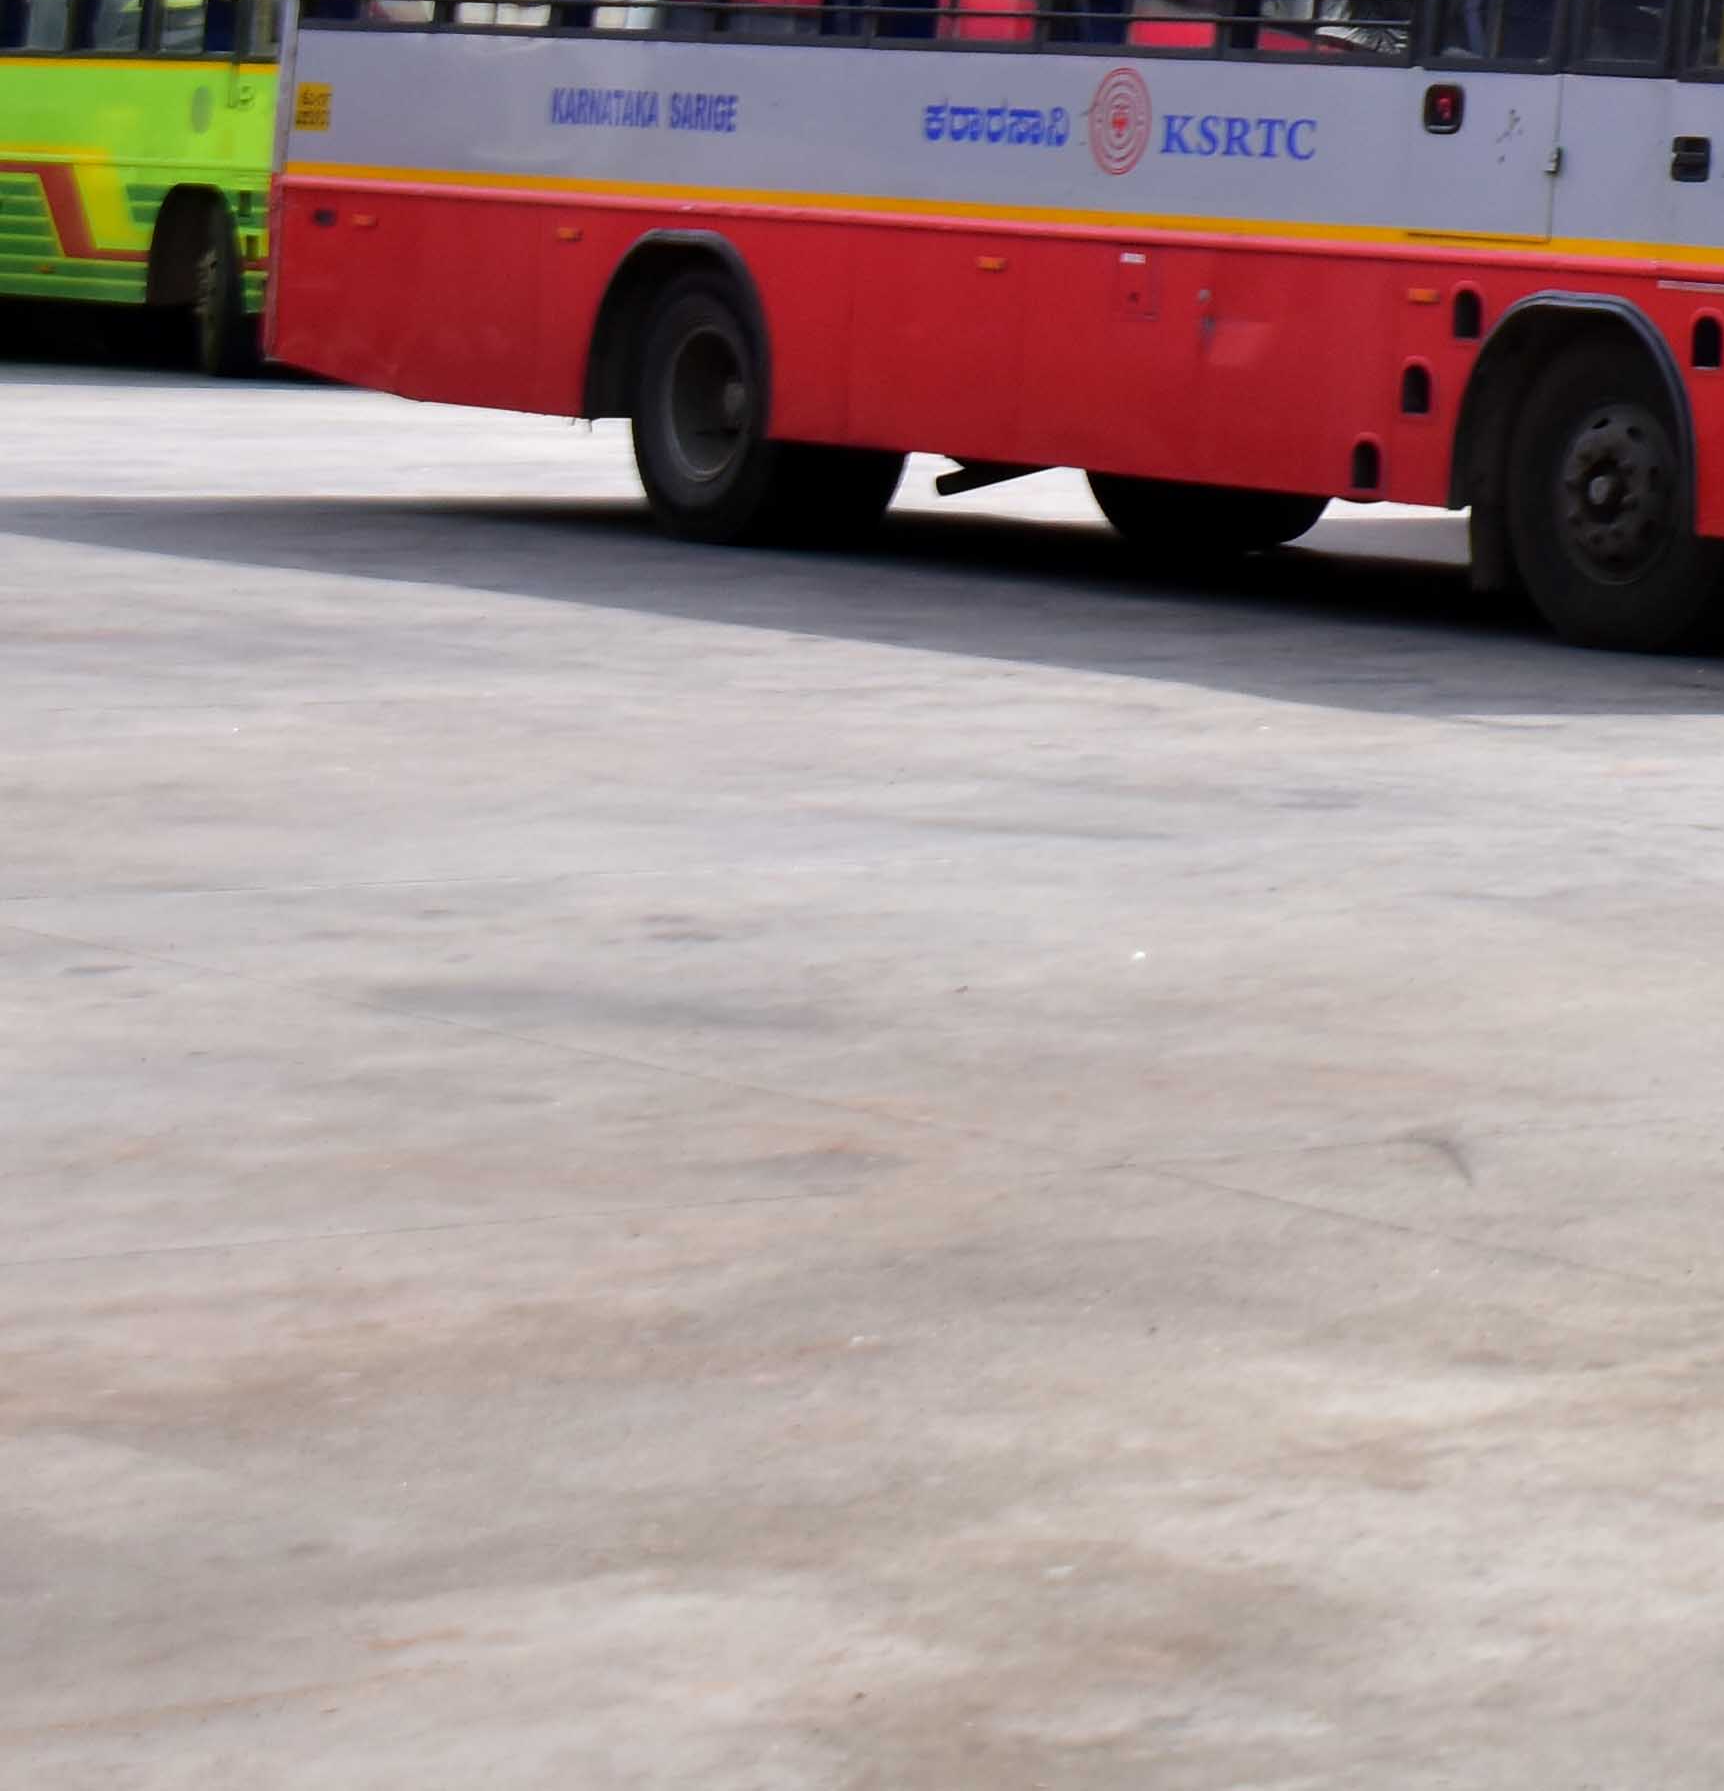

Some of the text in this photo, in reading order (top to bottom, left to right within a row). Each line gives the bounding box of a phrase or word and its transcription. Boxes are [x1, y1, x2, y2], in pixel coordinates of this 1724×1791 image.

[551, 88, 738, 132] KARNATAKA SARIGE
[1159, 114, 1319, 161] KSRTC
